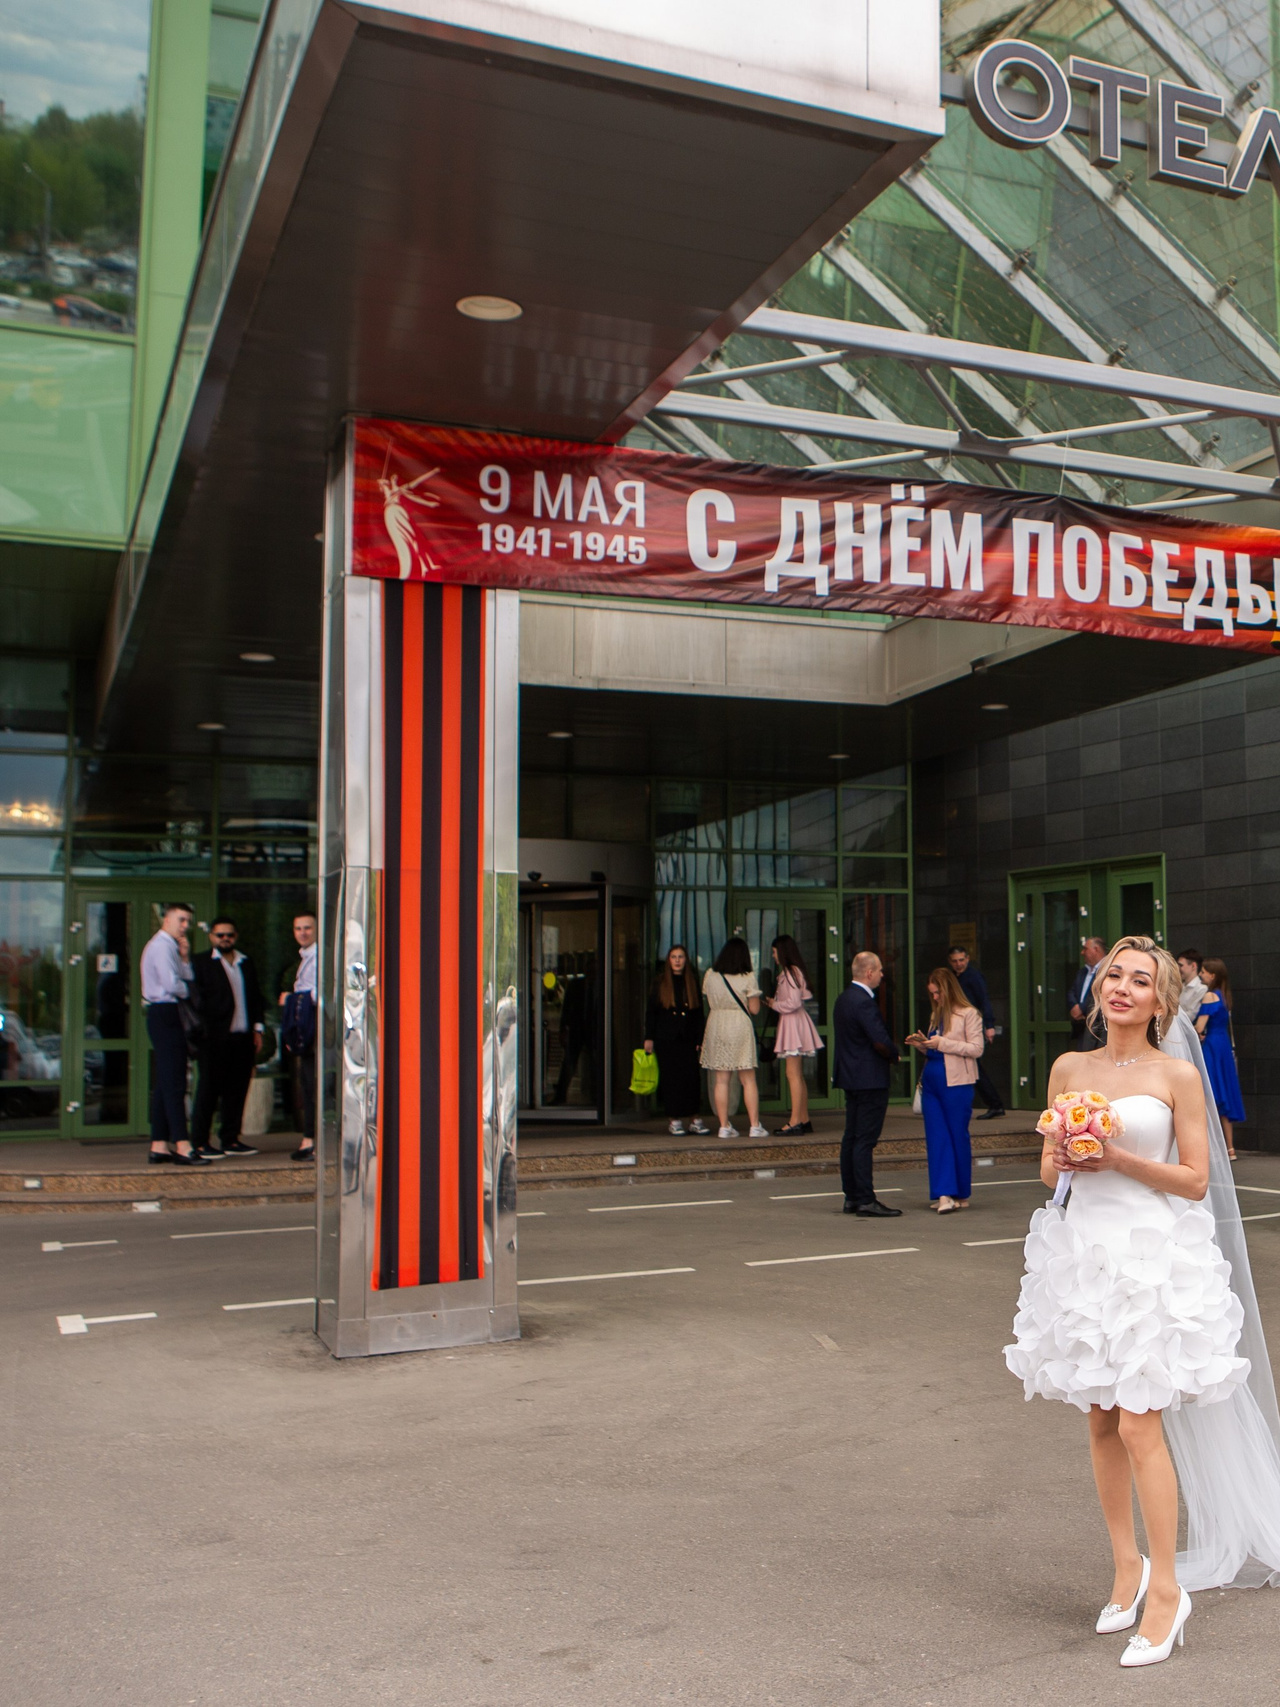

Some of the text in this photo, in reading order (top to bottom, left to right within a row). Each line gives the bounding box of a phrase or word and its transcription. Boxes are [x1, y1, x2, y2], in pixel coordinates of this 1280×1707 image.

[479, 464, 646, 528] 9 МАЯ
[478, 522, 647, 565] 1941-1945
[686, 488, 737, 573] С
[765, 483, 985, 596] ДНЁМ
